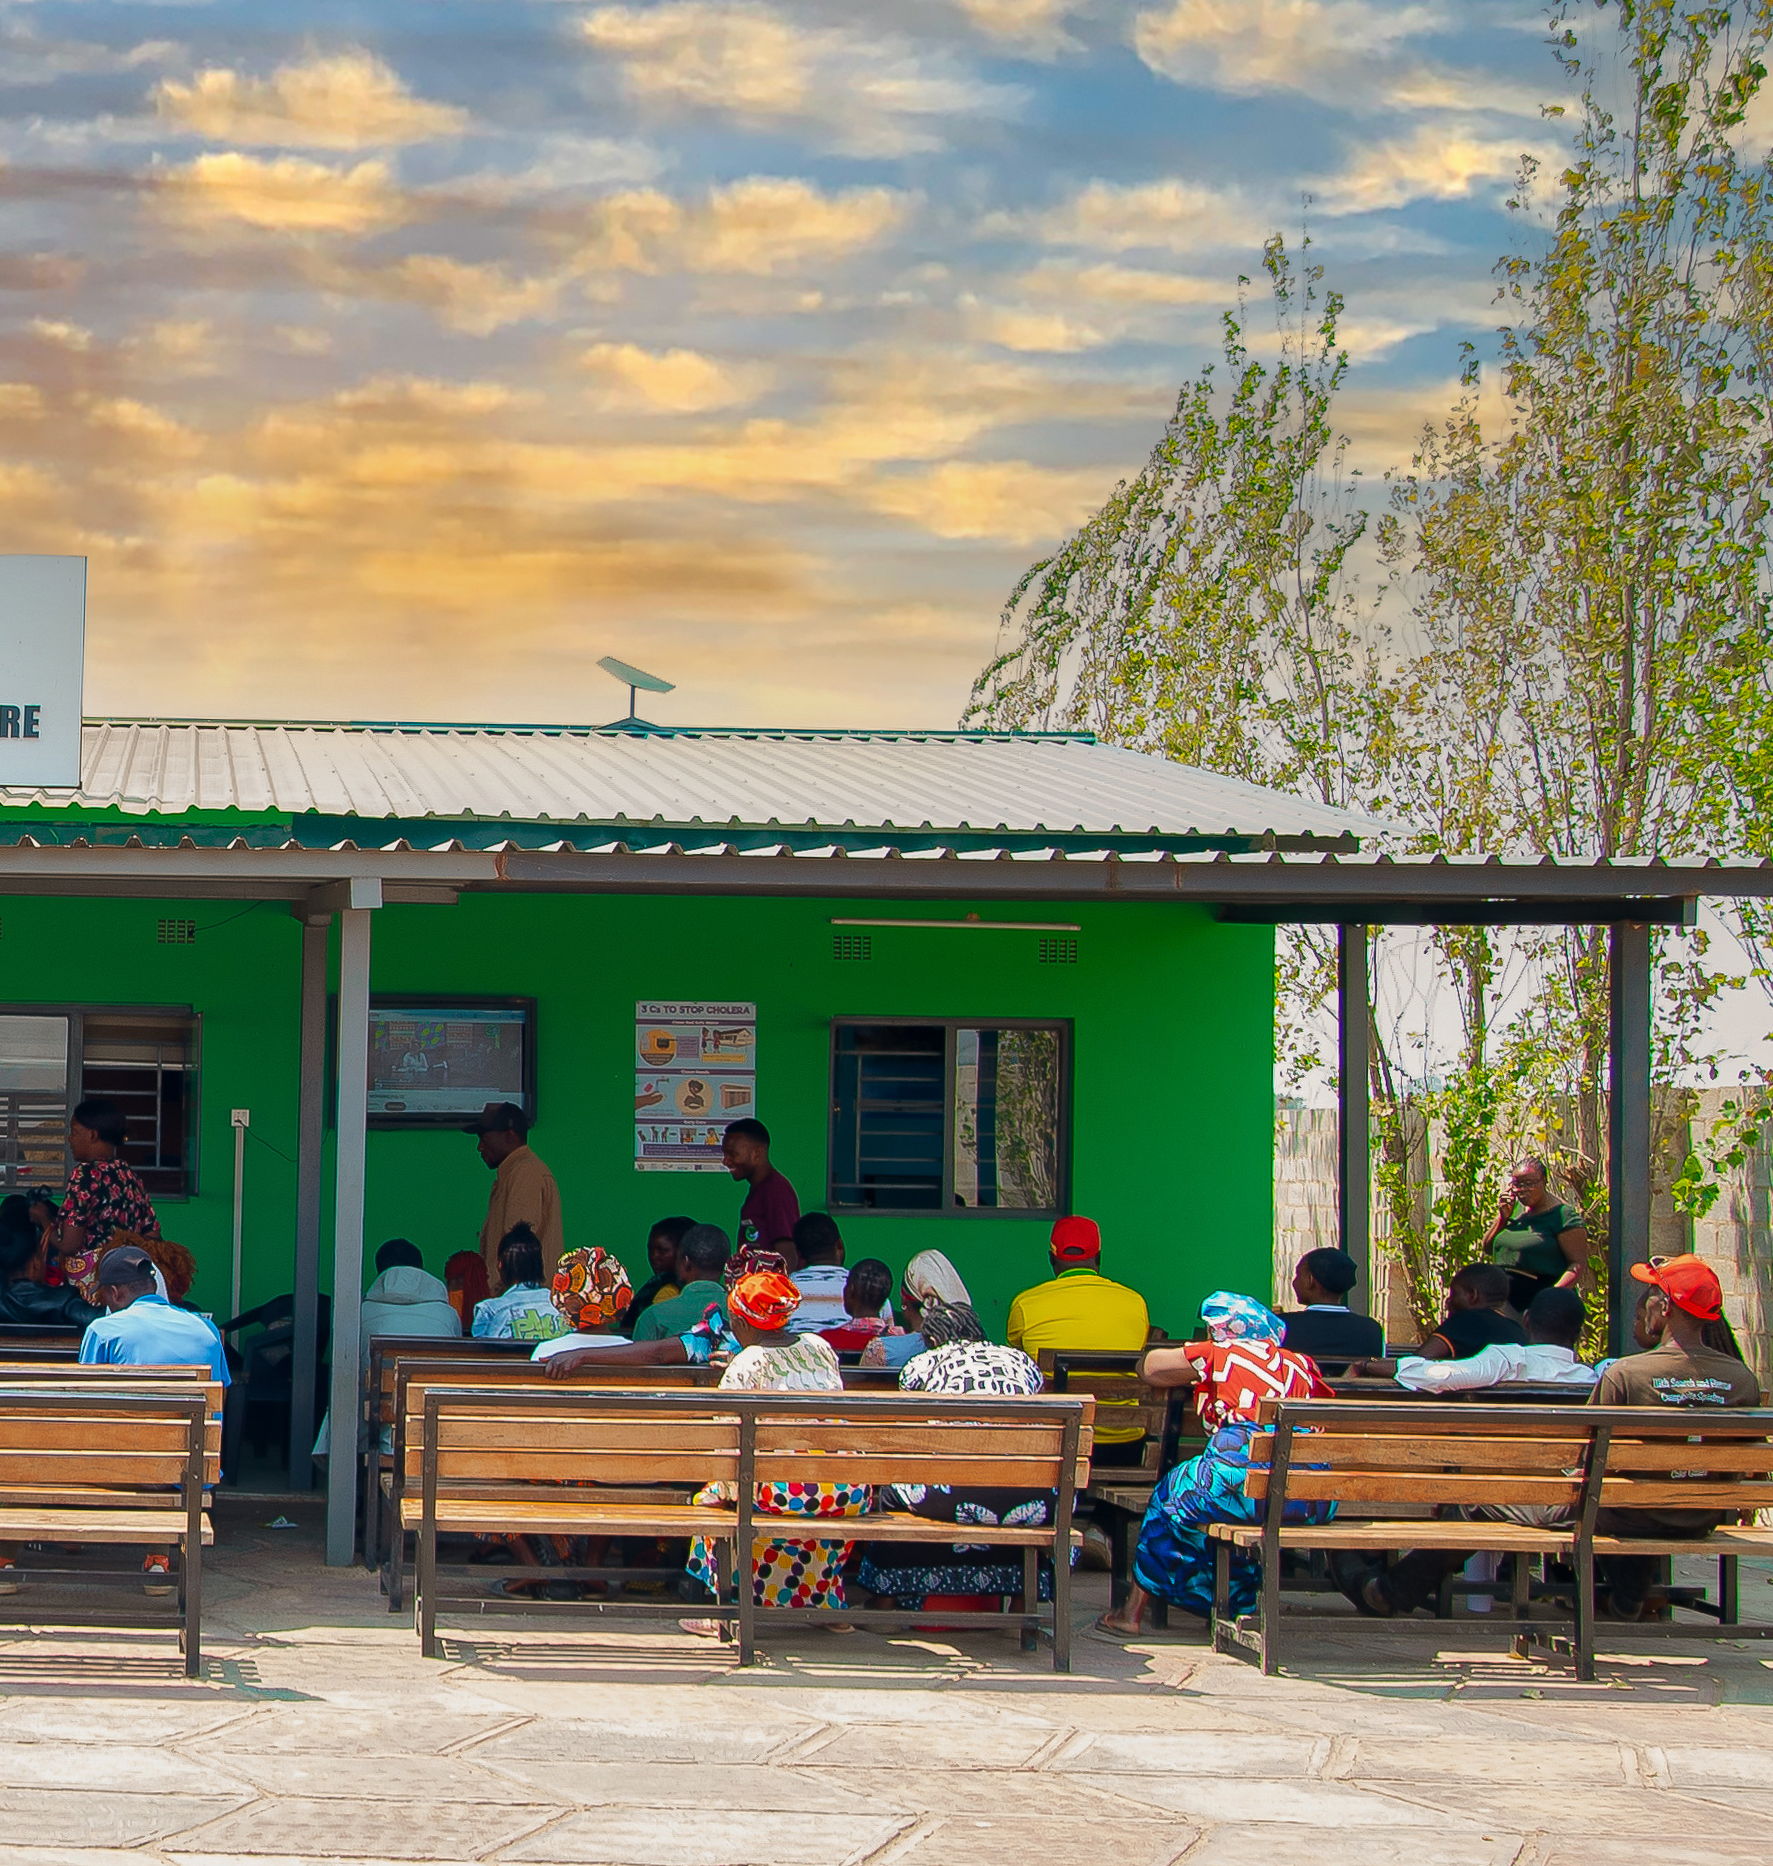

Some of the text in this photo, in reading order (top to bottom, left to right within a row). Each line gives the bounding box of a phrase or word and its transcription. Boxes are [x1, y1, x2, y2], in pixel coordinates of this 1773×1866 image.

[641, 1005, 647, 1013] 3
[662, 1005, 677, 1014] TO
[678, 1005, 705, 1014] STOP
[706, 1006, 750, 1015] CHOLERA
